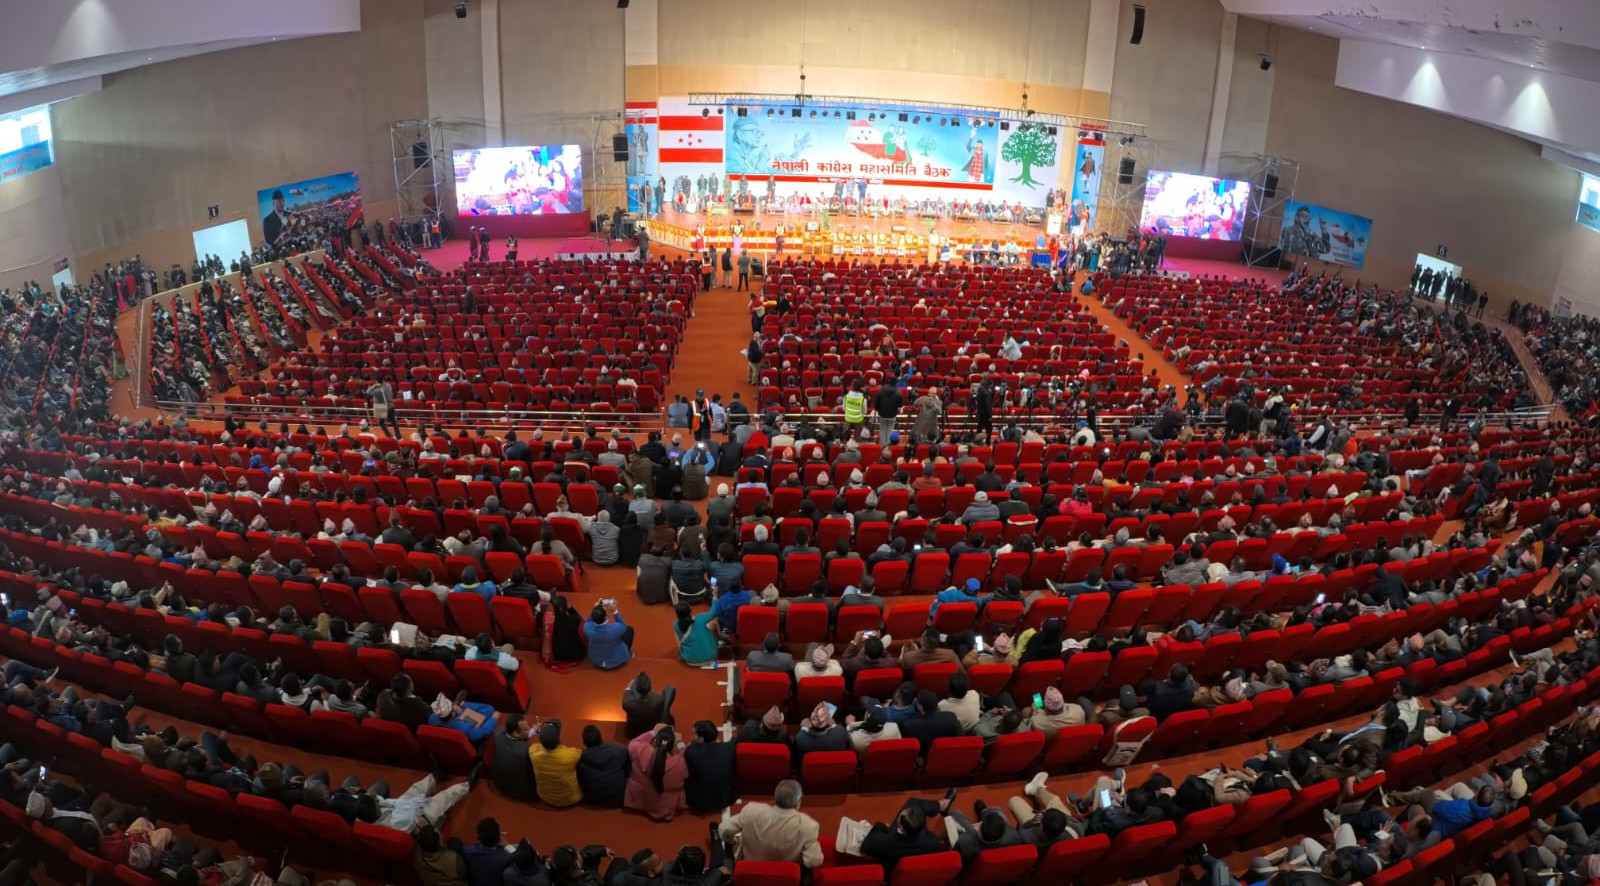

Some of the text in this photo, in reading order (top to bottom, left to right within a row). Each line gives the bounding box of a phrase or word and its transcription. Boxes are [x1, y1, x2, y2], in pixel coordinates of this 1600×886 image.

[772, 159, 952, 177] नेपाली कांग्रेस महासमिति बैठक
